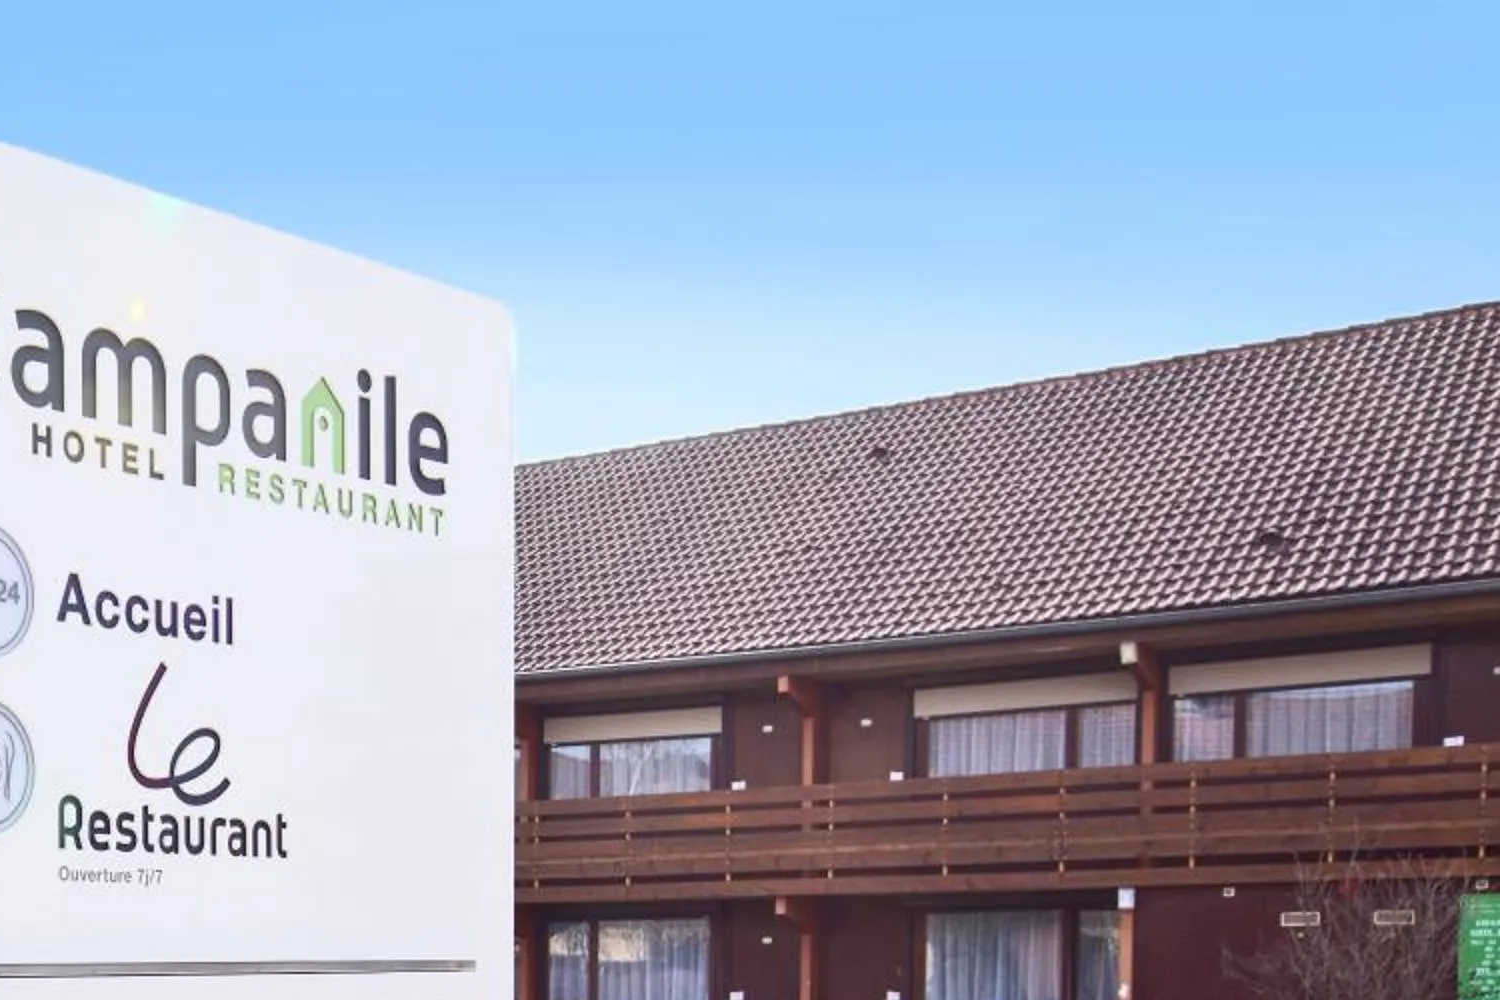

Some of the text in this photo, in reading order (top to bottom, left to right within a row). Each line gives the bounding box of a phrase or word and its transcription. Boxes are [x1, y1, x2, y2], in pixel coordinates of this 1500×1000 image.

[30, 422, 165, 481] HOTEL
[218, 463, 445, 537] RESTAURANT
[56, 572, 234, 645] Accueil
[58, 794, 288, 859] Restaurant
[58, 865, 163, 887] Ouverture 7j/7
